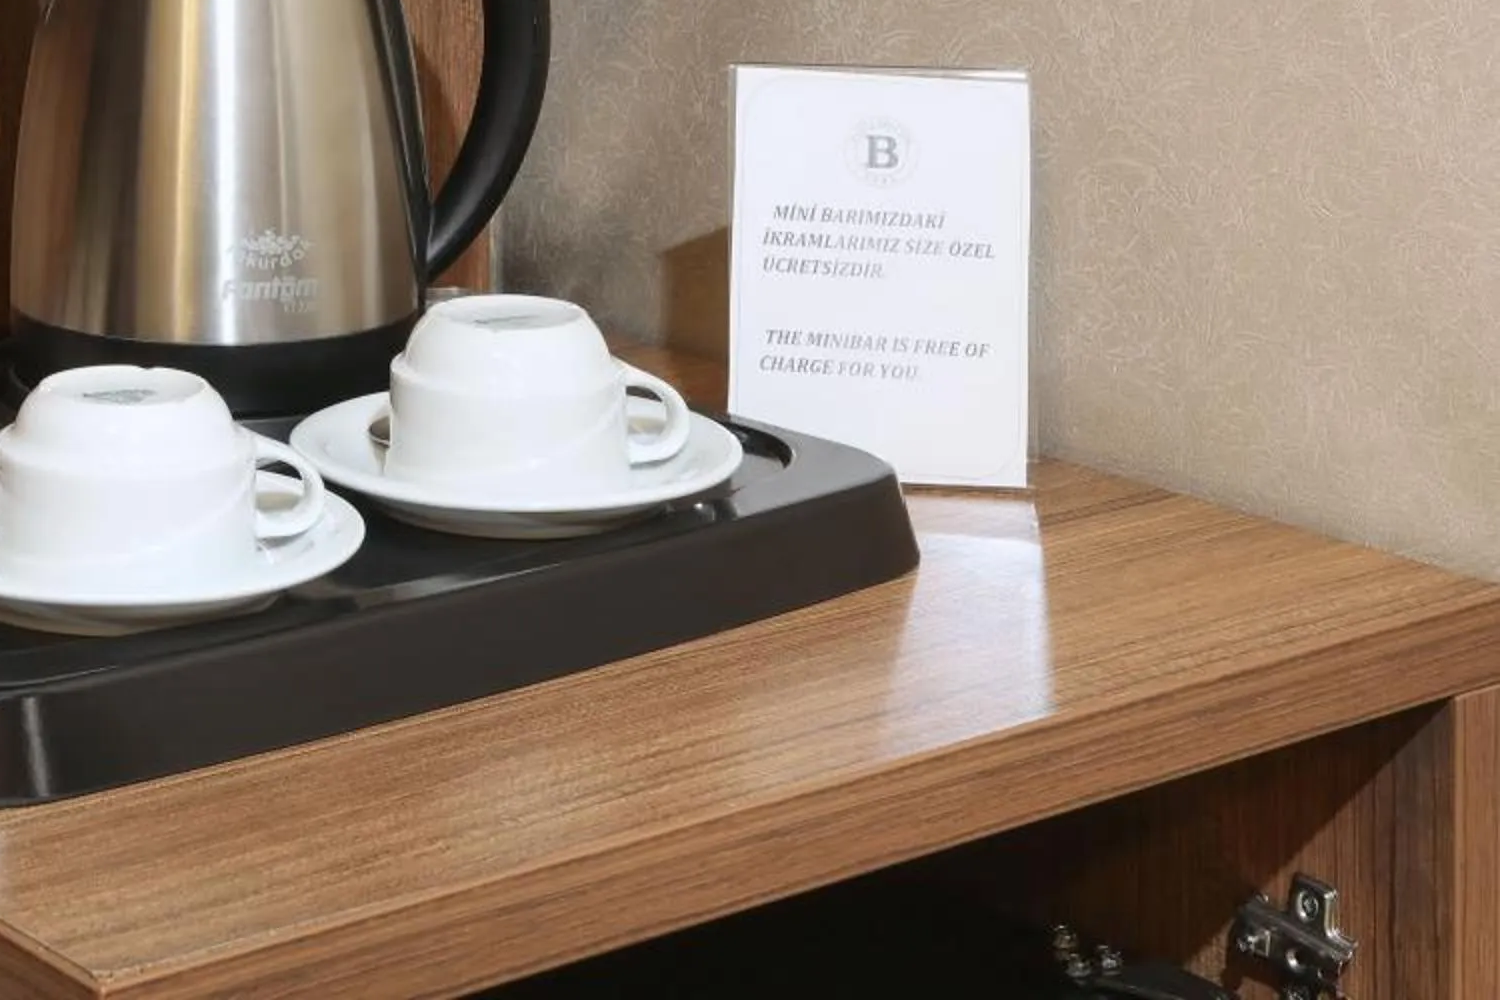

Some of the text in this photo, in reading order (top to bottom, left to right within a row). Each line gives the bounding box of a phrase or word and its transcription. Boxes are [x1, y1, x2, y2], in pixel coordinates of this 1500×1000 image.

[866, 134, 899, 169] B
[765, 329, 991, 359] THE MINIBAR IS FREE OF
[759, 355, 837, 376] CHARGE
[838, 361, 875, 378] FOR
